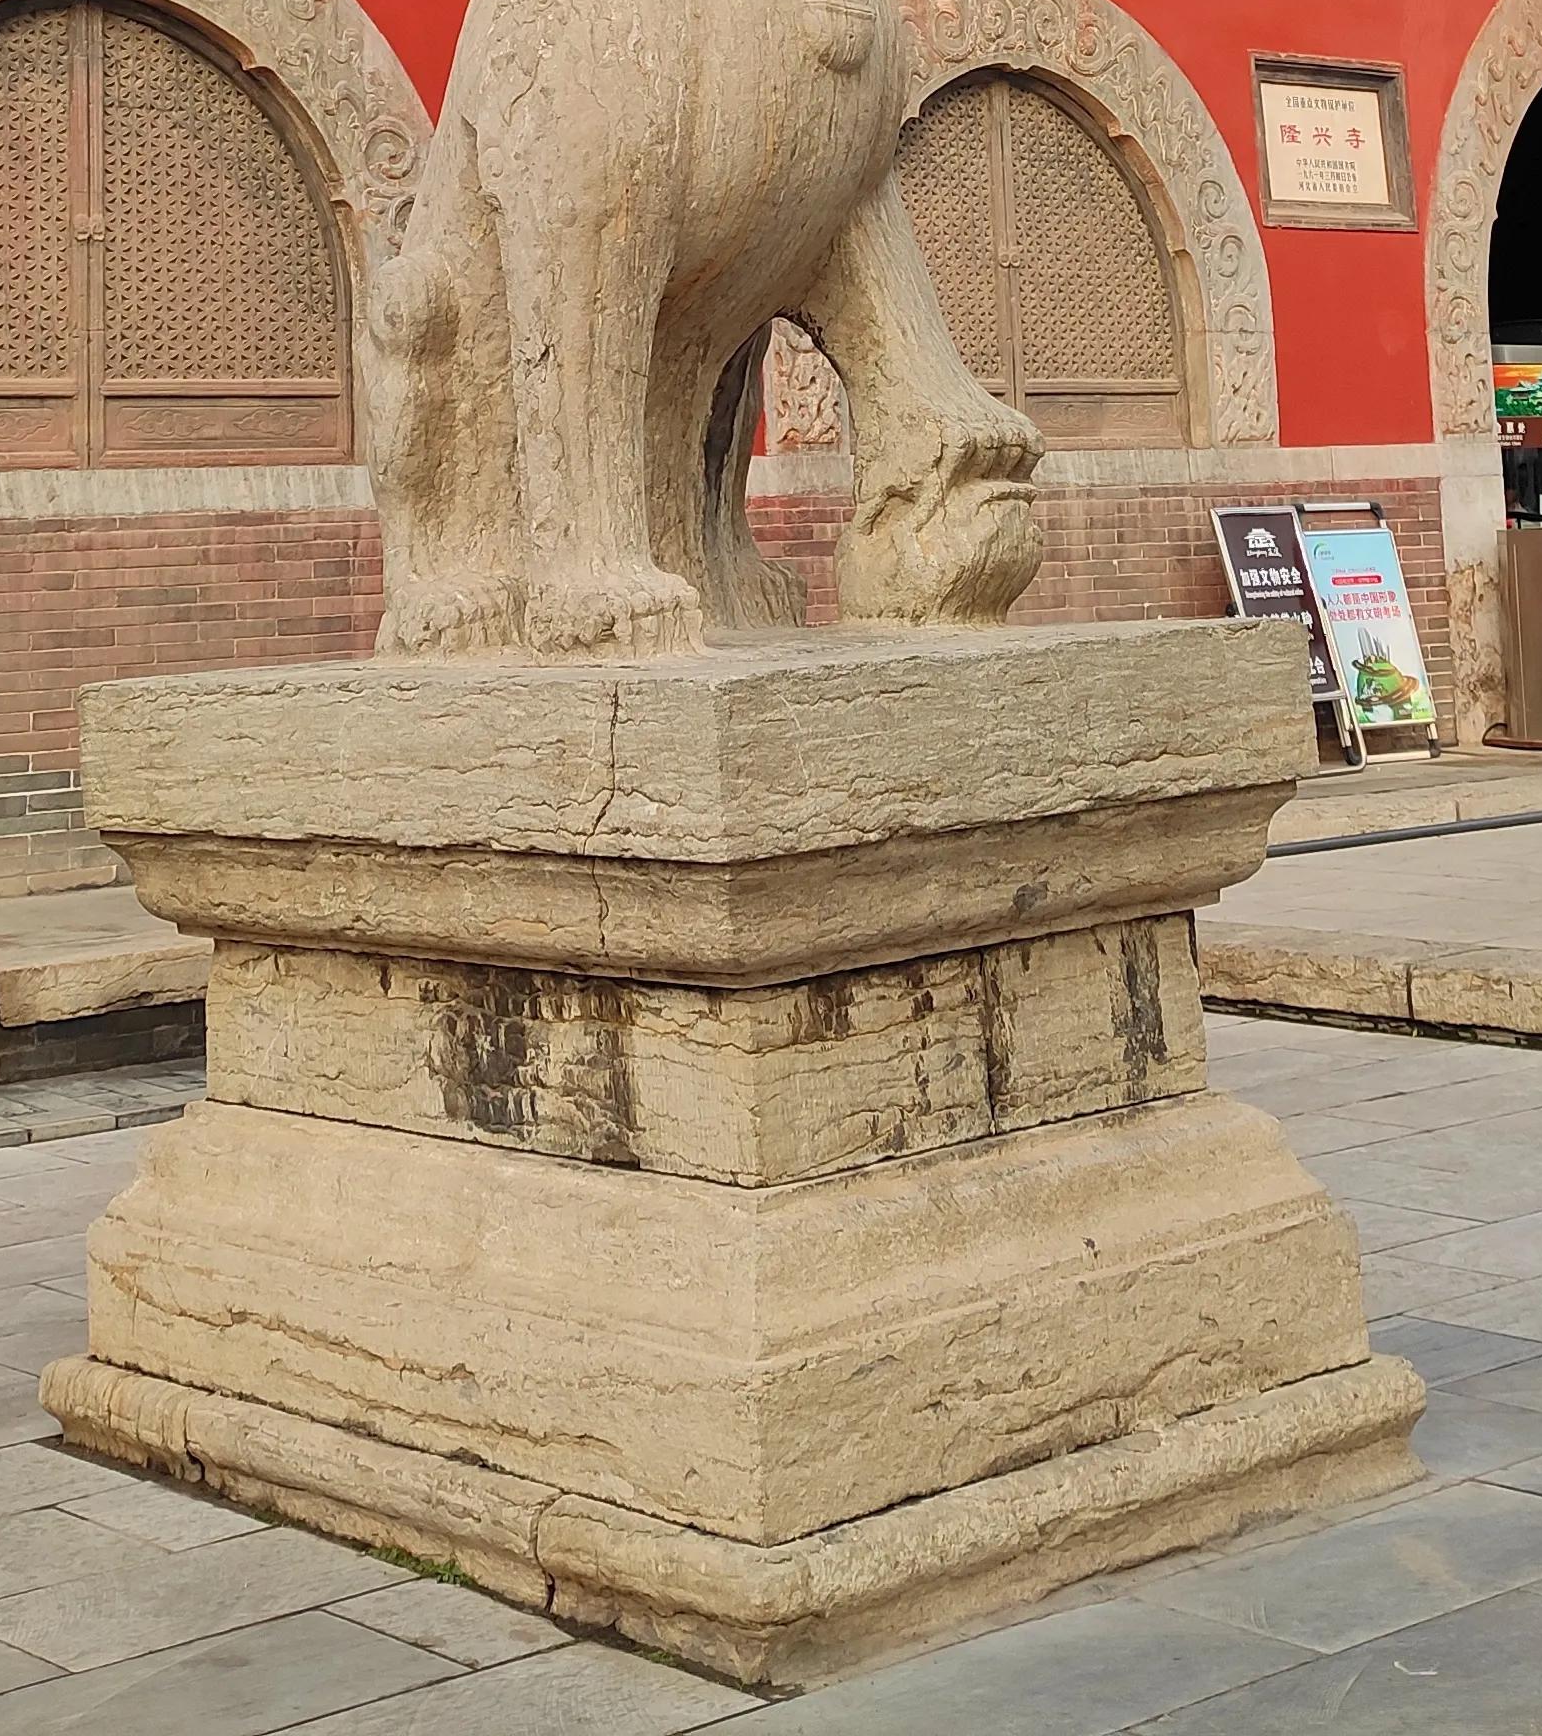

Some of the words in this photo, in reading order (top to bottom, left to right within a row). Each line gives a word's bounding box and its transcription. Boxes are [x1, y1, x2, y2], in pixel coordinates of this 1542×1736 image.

[1285, 96, 1355, 112] 全国重点文物保护单位
[1280, 124, 1365, 149] 隆兴寺
[1239, 566, 1303, 587] 加强文物安全
